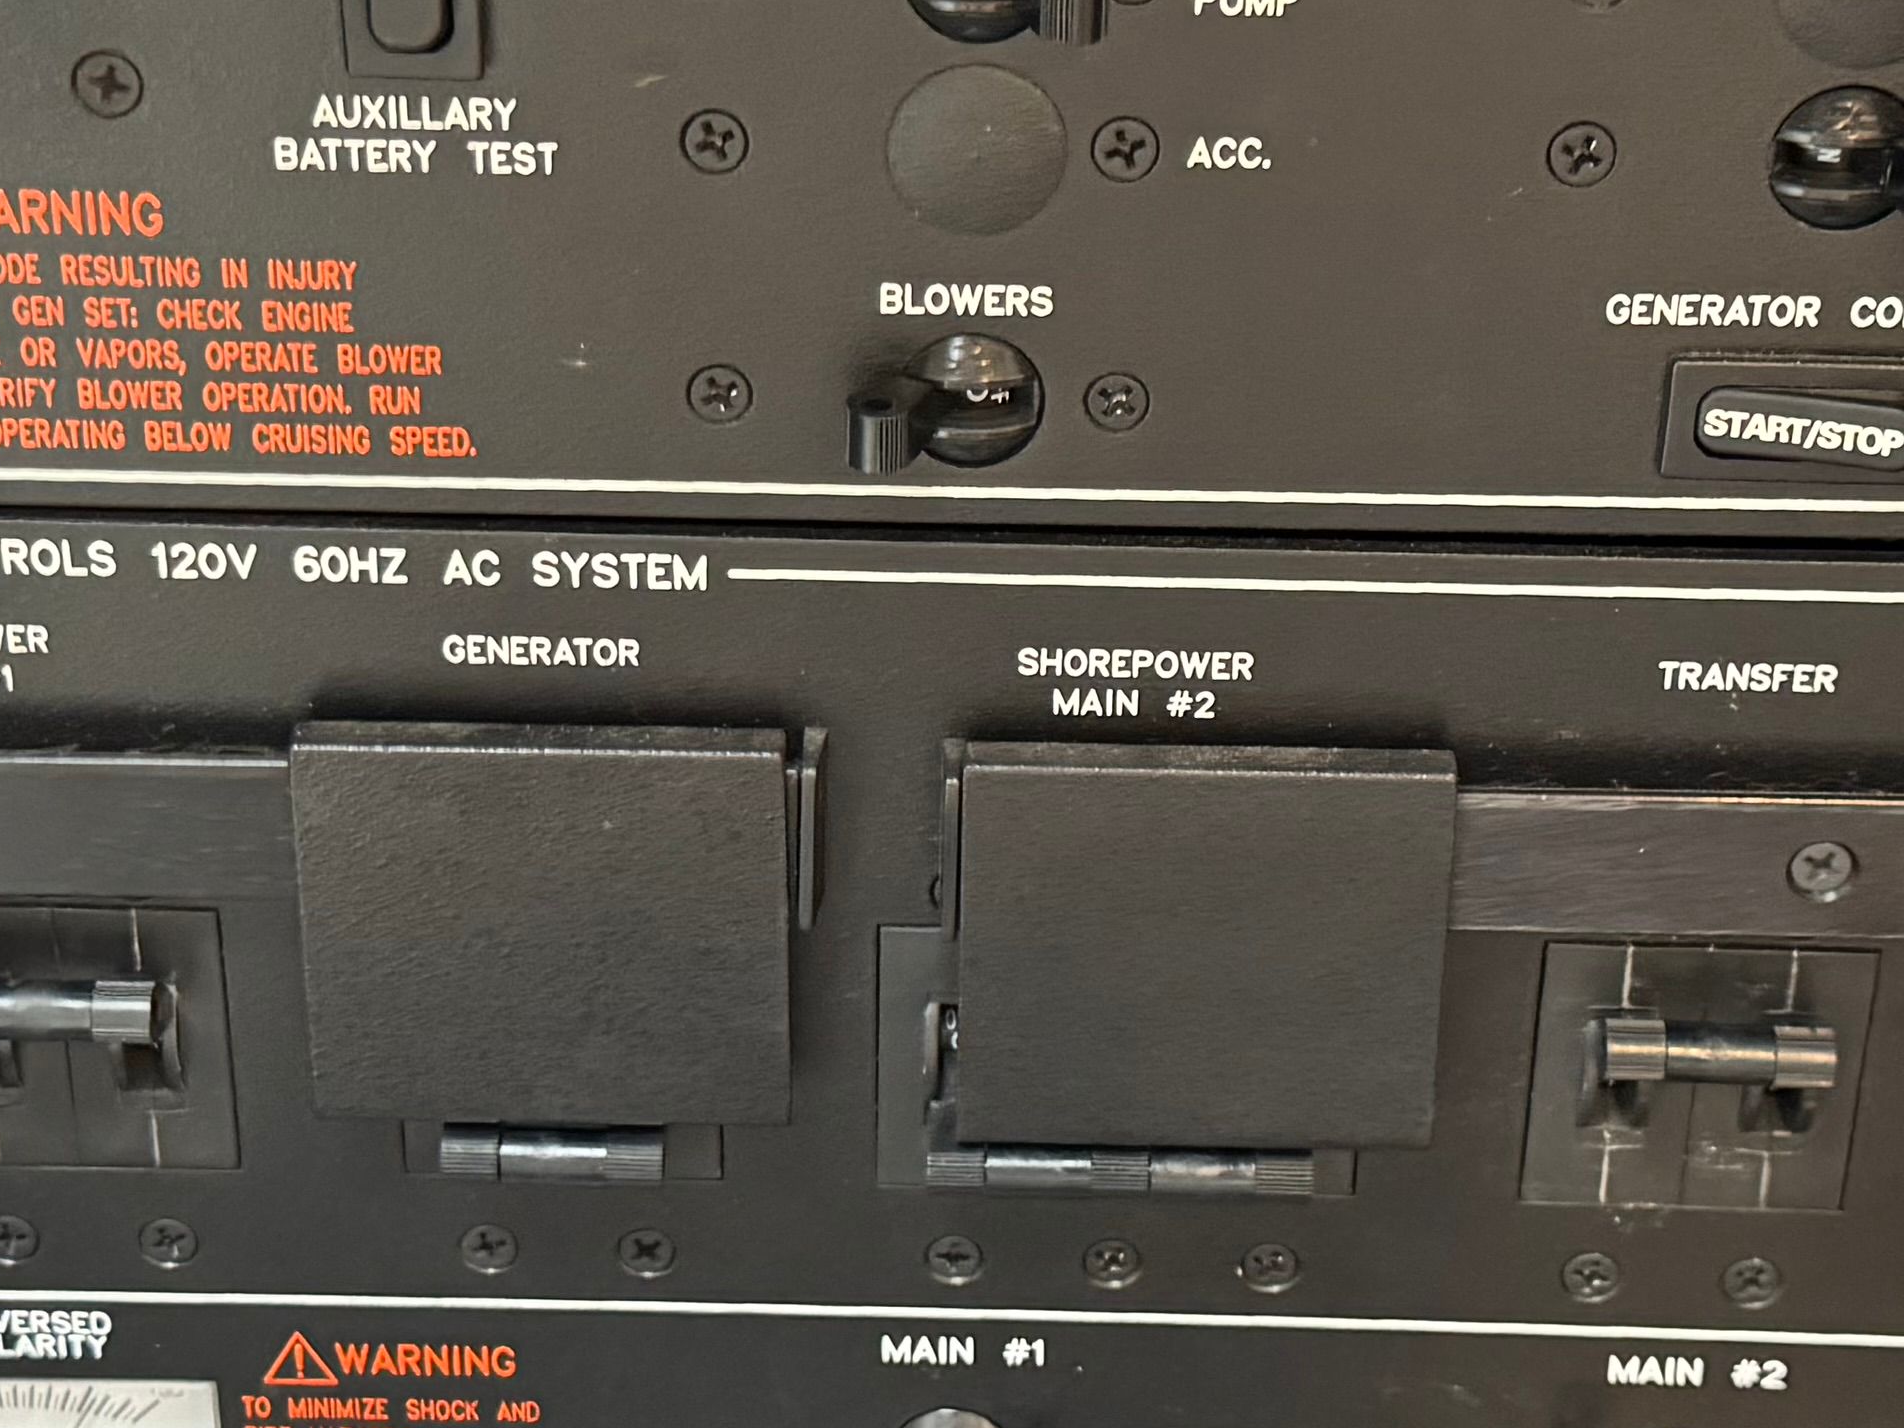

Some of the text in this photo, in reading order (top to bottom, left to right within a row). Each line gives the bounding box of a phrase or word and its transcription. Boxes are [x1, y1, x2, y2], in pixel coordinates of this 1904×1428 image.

[311, 93, 517, 132] AUXILLARY
[272, 135, 559, 176] BATTERY TEST
[1186, 135, 1272, 170] ACC.
[60, 253, 202, 290] RESULTING
[220, 259, 250, 289] IN
[268, 259, 358, 293] INJURY
[879, 281, 1054, 318] BLOWERS
[1605, 292, 1822, 328] GENERATOR
[150, 540, 258, 580] 120V
[291, 544, 409, 585] 60HZ
[442, 548, 501, 587] AC
[531, 550, 708, 592] SYSTEM
[441, 633, 640, 667] GENERATOR
[1017, 646, 1255, 681] SHOREPOWER
[1658, 660, 1839, 693] TRANSFER
[1052, 687, 1216, 719] MAIN #2
[335, 1343, 517, 1379] WARNING
[880, 1334, 1045, 1367] MAIN #1
[1606, 1354, 1788, 1390] MAIN #2
[241, 1395, 541, 1424] TO MINIMIZE SHOCK AND
